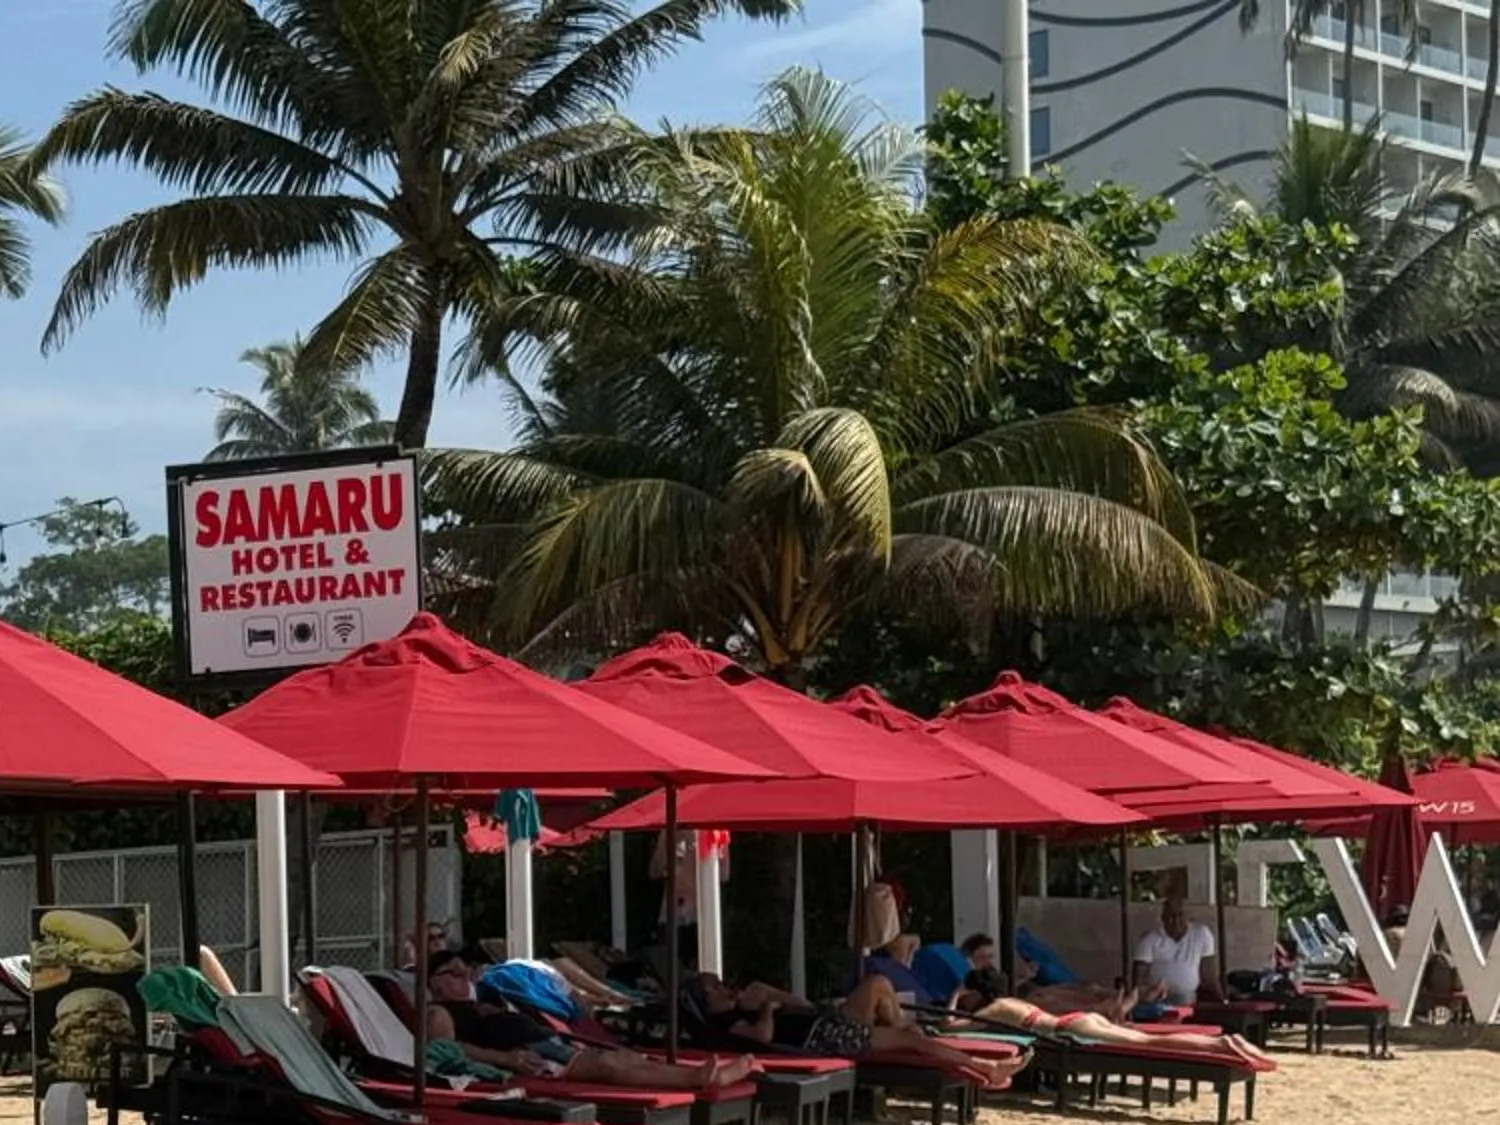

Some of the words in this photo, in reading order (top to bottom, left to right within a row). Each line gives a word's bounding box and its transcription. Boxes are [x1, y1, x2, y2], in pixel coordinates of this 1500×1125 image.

[195, 473, 403, 548] SAMARU
[231, 540, 333, 576] HOTEL
[344, 538, 370, 565] &
[199, 568, 405, 612] RESTAURANT
